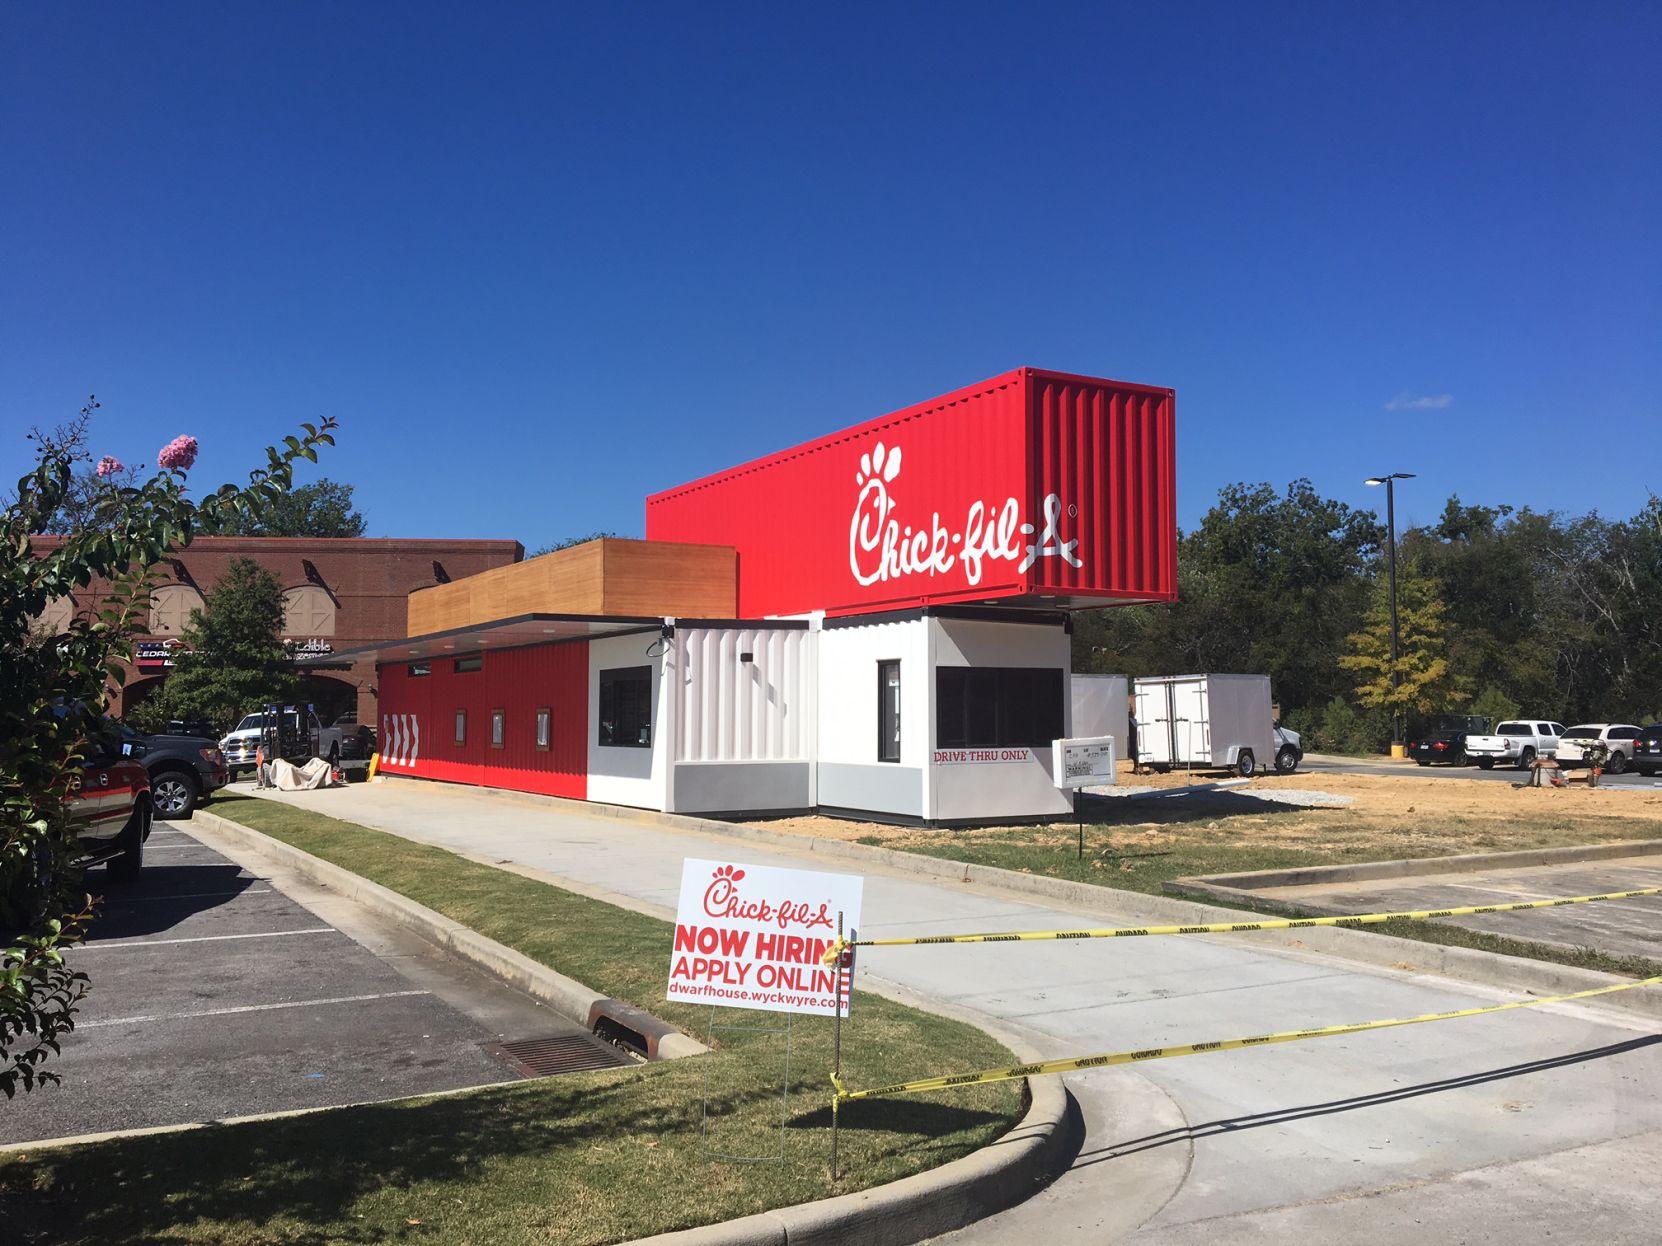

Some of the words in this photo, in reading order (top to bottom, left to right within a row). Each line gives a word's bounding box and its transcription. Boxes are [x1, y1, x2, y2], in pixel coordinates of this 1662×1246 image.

[850, 478, 1083, 586] Chick-fil-A
[934, 751, 967, 762] DRIVE
[969, 750, 998, 761] THRU
[1001, 750, 1029, 760] ONLY
[703, 877, 833, 929] Chick-fil-A
[674, 924, 750, 957] NOW
[671, 956, 752, 986] APPLY
[757, 964, 851, 996] ONLINE
[669, 982, 848, 1009] dwarfhouse.wyckwyre.com
